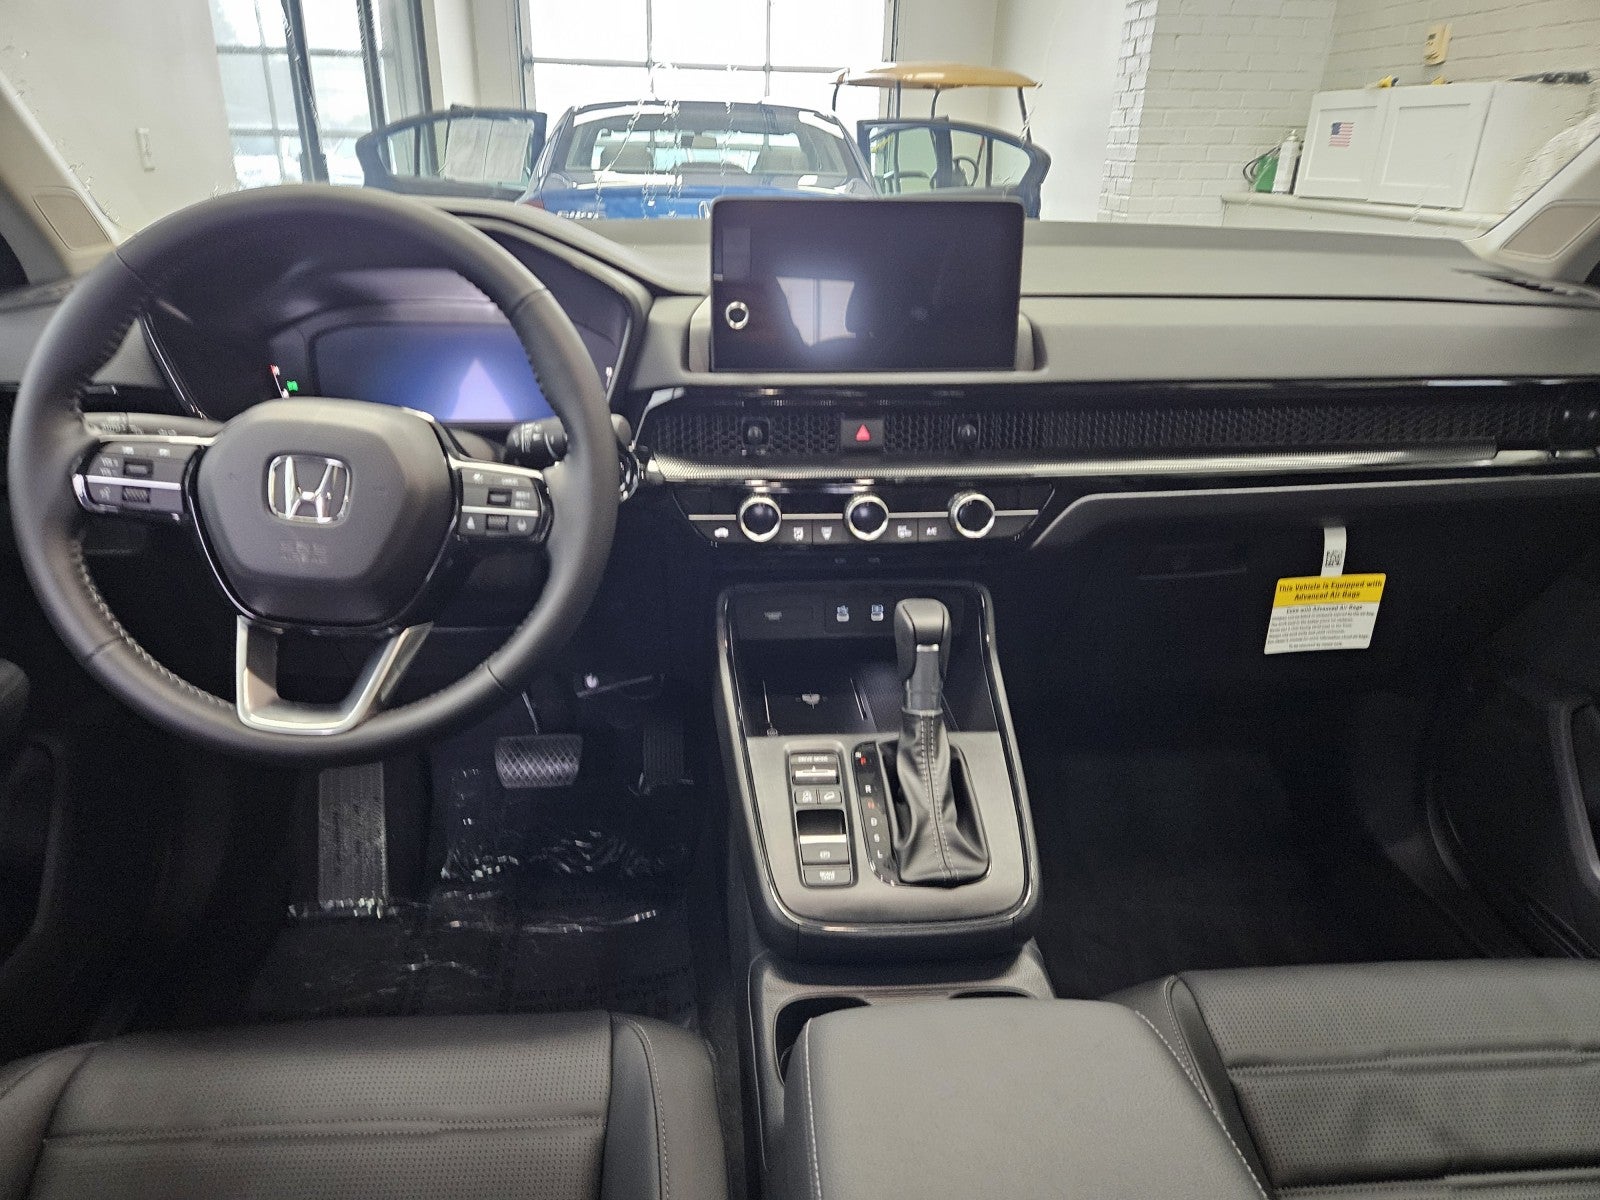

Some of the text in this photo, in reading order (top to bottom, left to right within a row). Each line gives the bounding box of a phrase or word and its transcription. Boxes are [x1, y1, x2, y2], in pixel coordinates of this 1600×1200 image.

[1295, 583, 1320, 591] Vehicle
[1331, 581, 1364, 590] Equipped
[1366, 580, 1383, 588] with
[1294, 592, 1328, 601] Advanced
[865, 785, 871, 793] R
